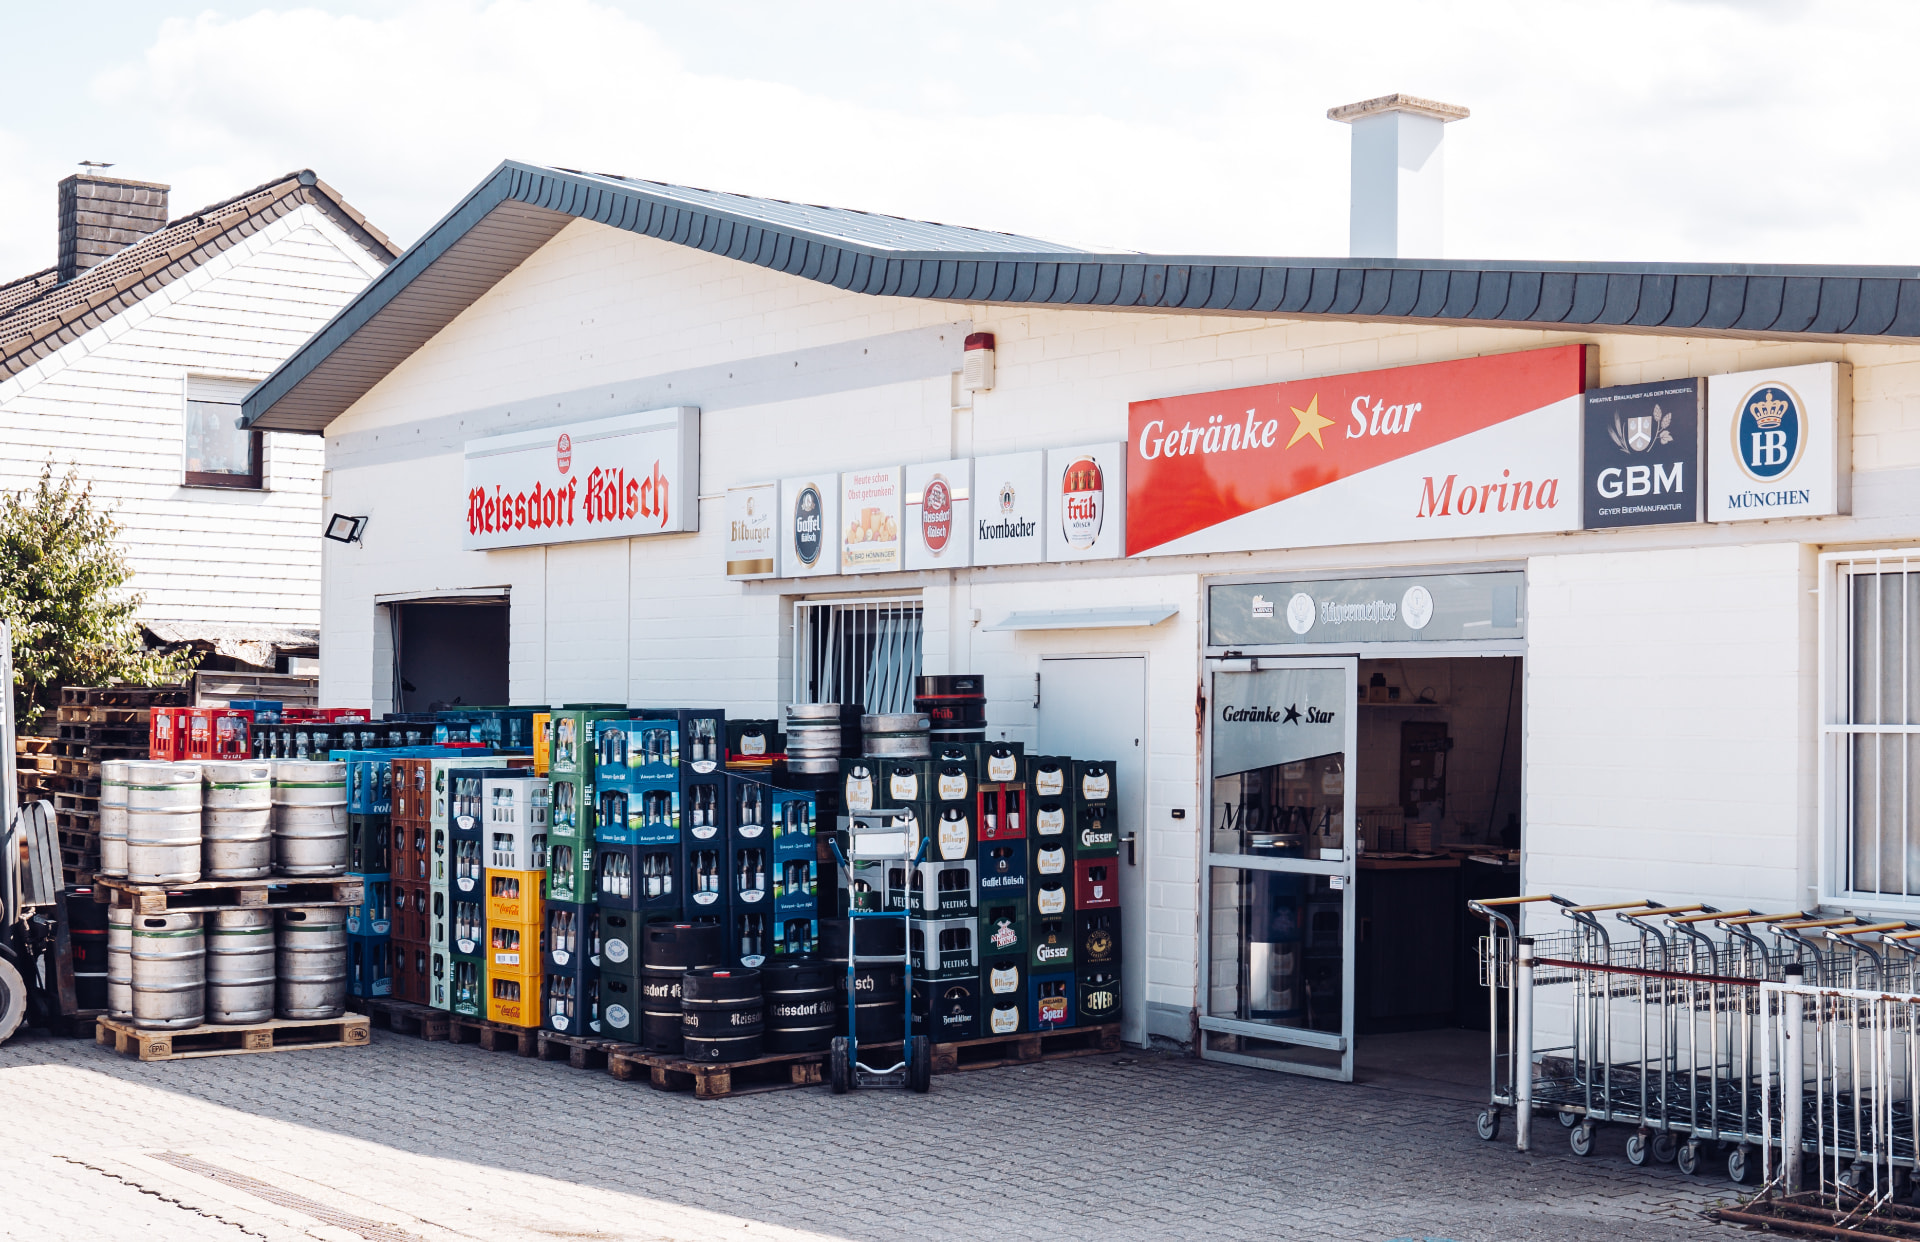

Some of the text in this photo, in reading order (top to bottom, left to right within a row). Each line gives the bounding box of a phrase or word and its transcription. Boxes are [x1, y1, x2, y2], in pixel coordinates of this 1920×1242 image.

[1138, 394, 1423, 461] Getränke Star
[1750, 429, 1789, 468] HB
[853, 472, 889, 486] Heute schon
[1596, 461, 1685, 499] GBM
[466, 458, 670, 537] Reissdorf Kölsch
[848, 484, 895, 502] Obst getrunken?
[1415, 468, 1560, 519] Morina
[1727, 489, 1811, 510] MÜNCHEN
[1067, 495, 1097, 521] früh
[1598, 507, 1621, 516] GEYER
[731, 519, 771, 544] Bitburger
[796, 514, 821, 533] Gaffel
[978, 516, 1036, 541] Krombacher
[1222, 704, 1335, 724] Getränke Star
[585, 719, 595, 742] EIFEL
[584, 783, 594, 806] EIFEL
[1218, 801, 1333, 838] MORINA
[1081, 828, 1113, 847] Gösser
[582, 848, 592, 871] EIFEL
[981, 874, 1025, 887] Gaffel Kölsch
[941, 899, 968, 910] VELTINS
[1036, 943, 1069, 962] Gösser
[942, 959, 969, 969] VELTINS
[1087, 990, 1113, 1010] JEVER
[1042, 1006, 1064, 1022] Spezi
